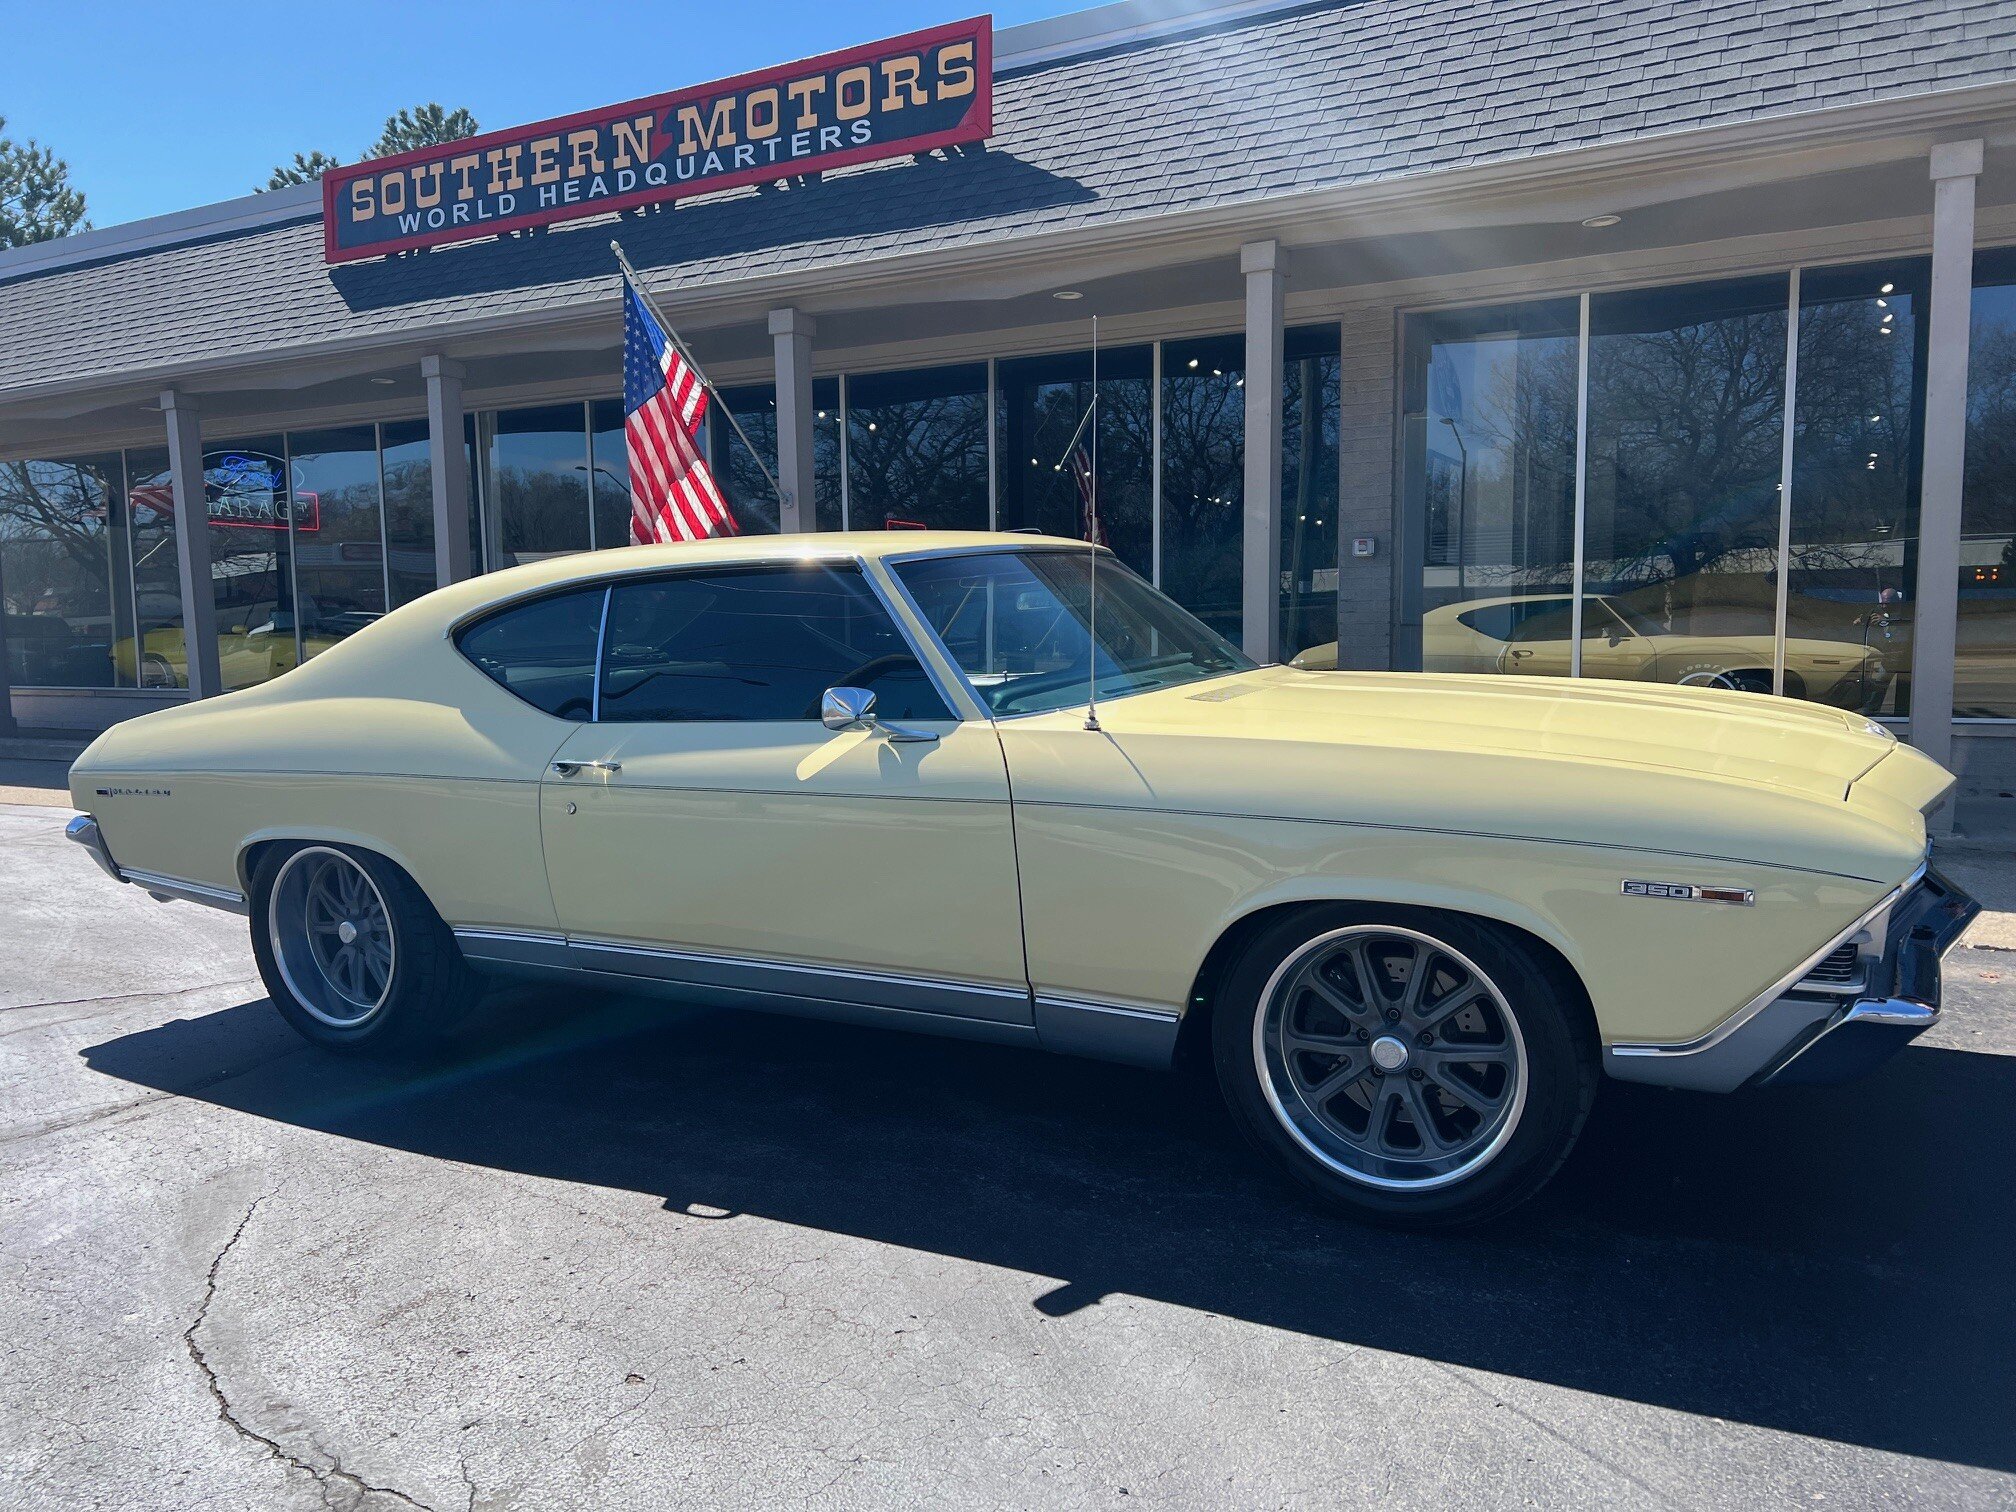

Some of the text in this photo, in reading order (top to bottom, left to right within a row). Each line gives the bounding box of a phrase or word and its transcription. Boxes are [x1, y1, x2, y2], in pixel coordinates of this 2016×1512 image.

[351, 41, 976, 223] SOUTHERN MOTORS
[398, 119, 873, 235] WORLD HEADQUARTERS
[214, 455, 283, 489] Ford
[1626, 882, 1690, 898] 350
